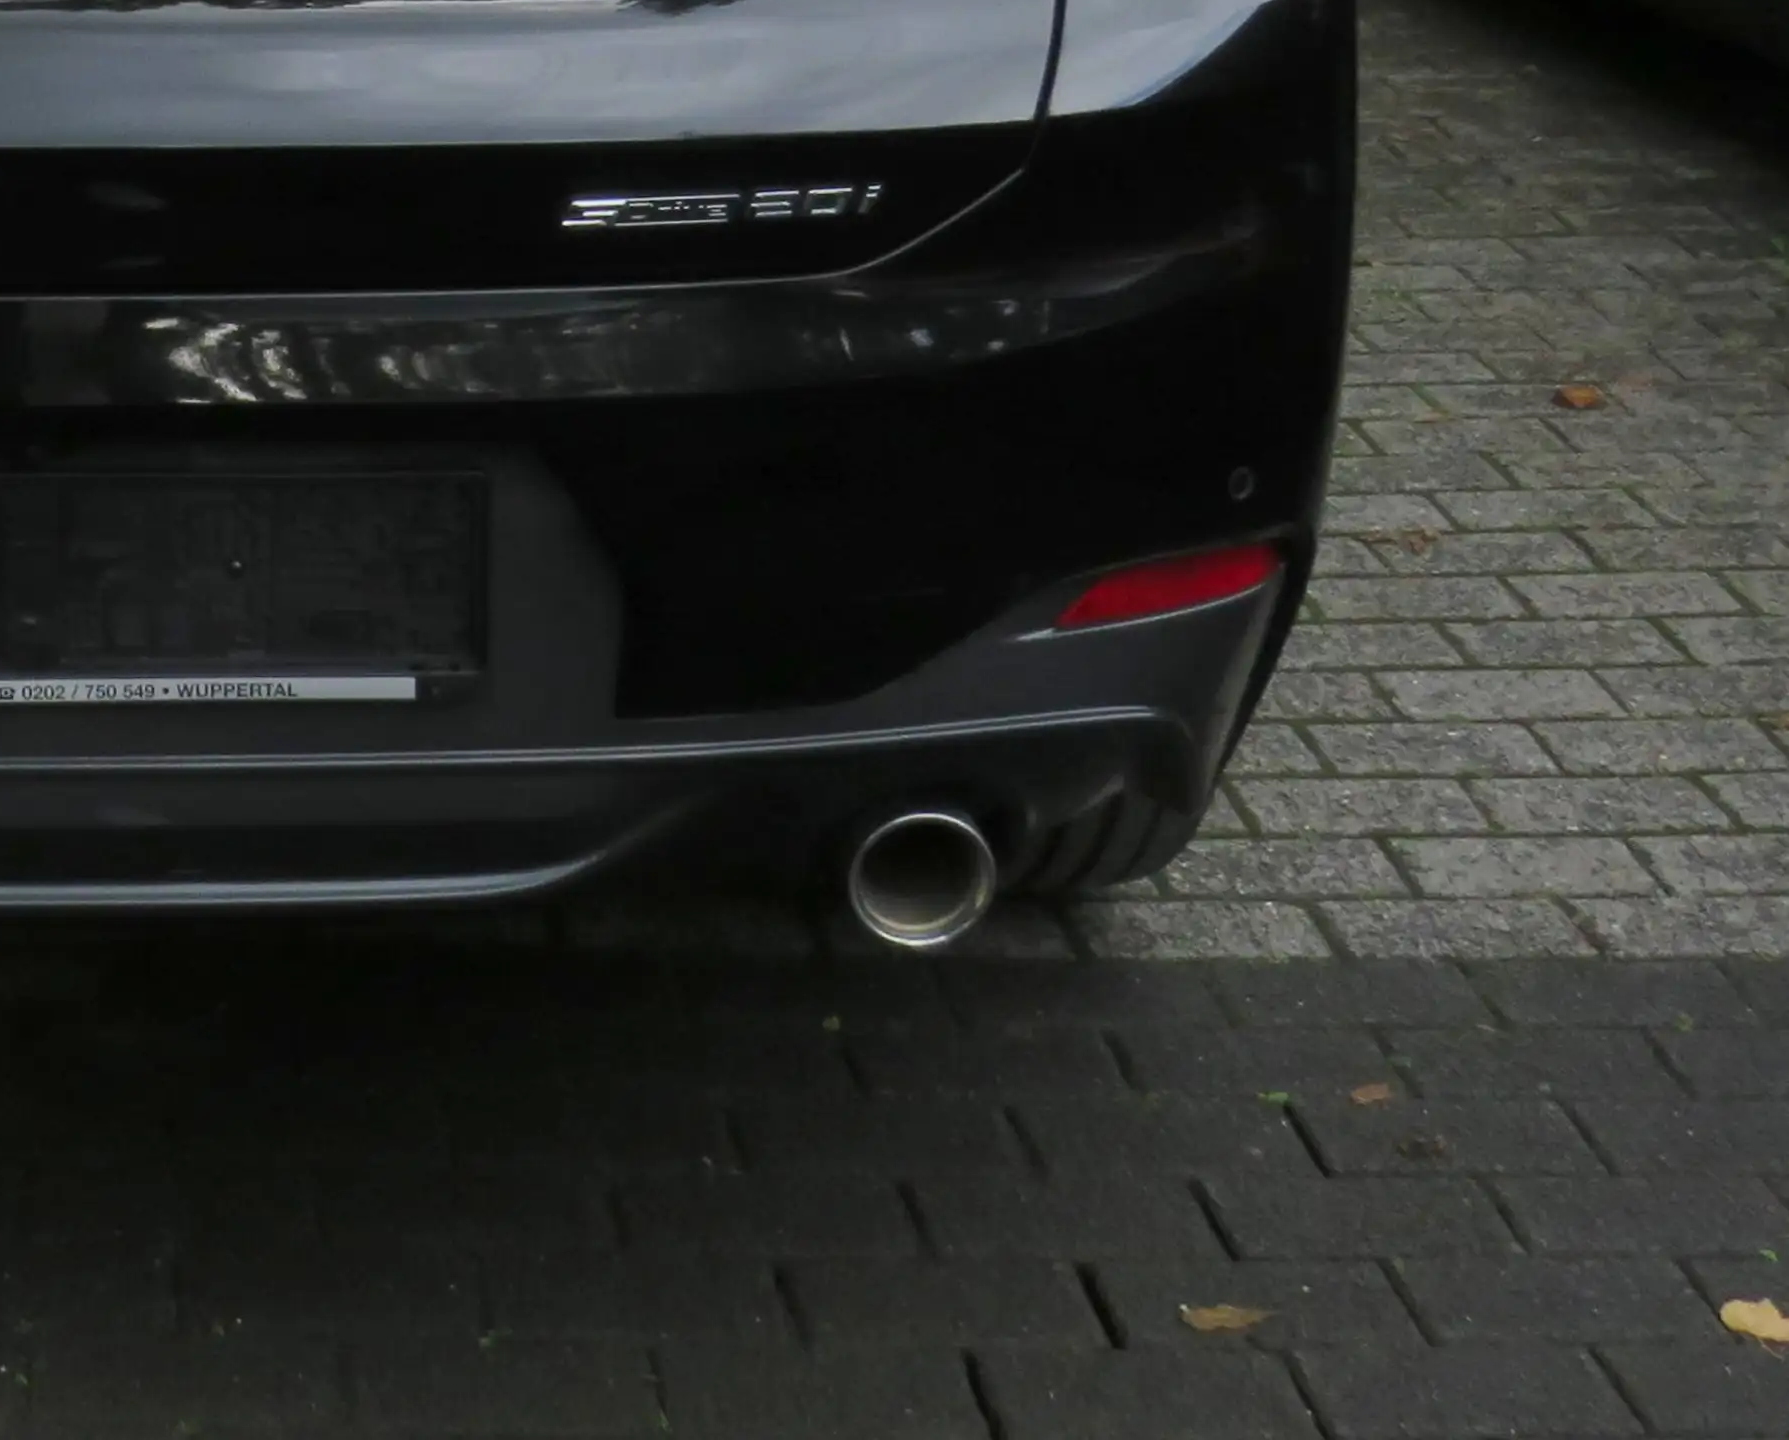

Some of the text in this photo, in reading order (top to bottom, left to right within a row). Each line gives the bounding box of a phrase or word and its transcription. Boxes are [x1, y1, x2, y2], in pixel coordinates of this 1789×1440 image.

[21, 684, 67, 701] 0202
[84, 683, 118, 700] 750
[122, 682, 156, 699] 549
[176, 682, 299, 699] WUPPERTAL
